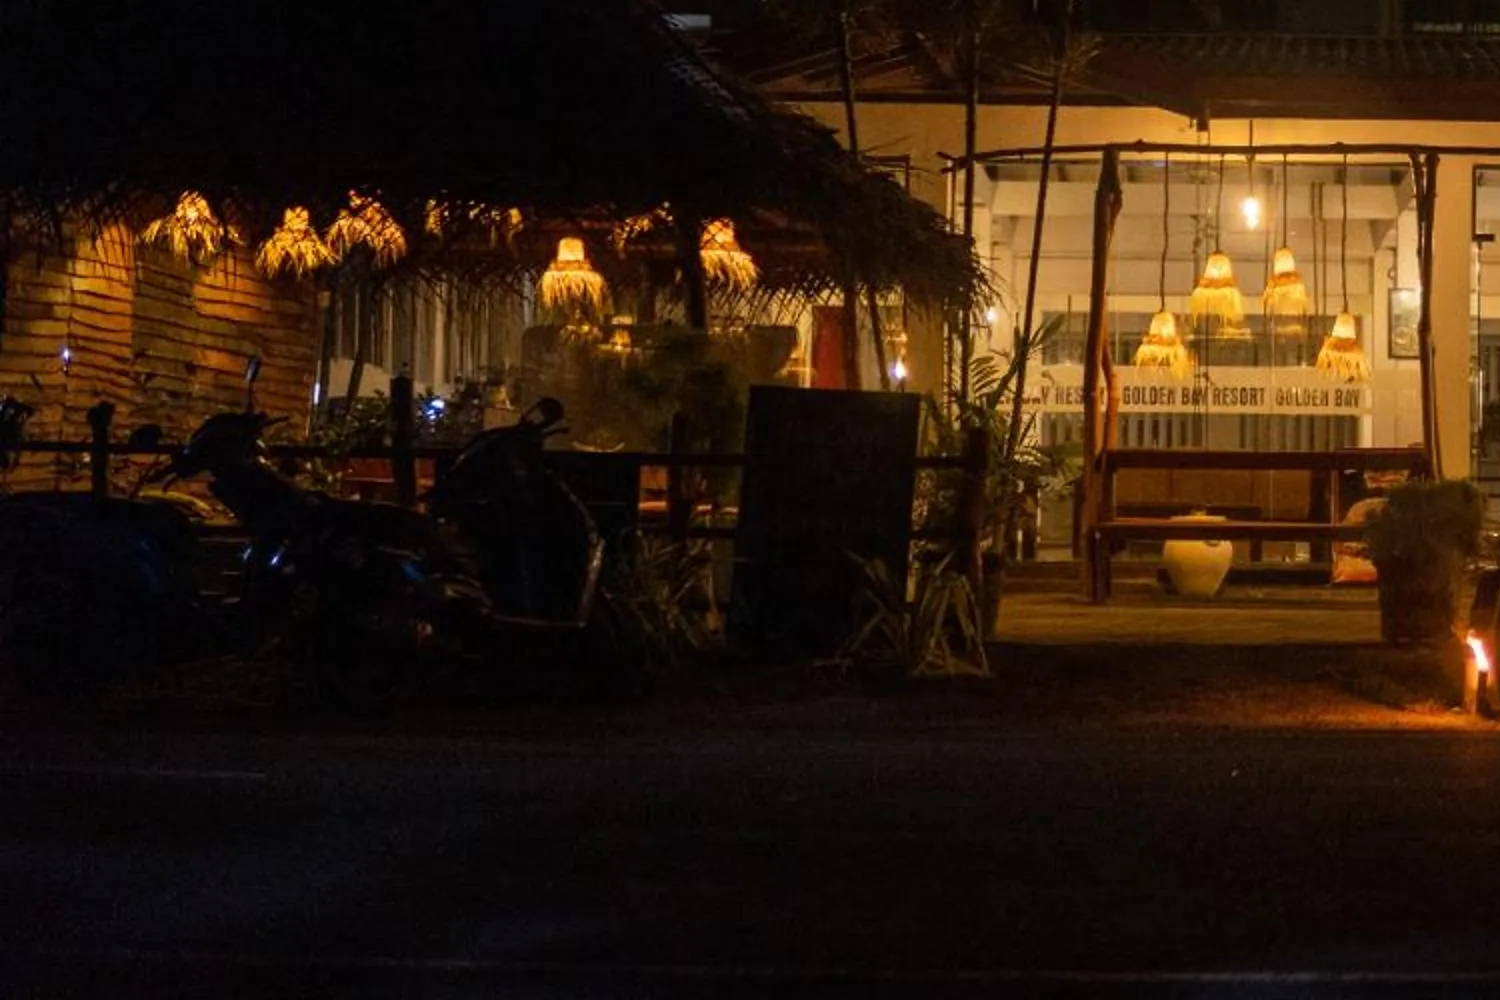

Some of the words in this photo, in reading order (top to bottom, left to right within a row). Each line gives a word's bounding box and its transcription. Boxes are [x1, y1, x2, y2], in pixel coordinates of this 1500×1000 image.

[1123, 386, 1176, 405] GOLDEN
[1181, 387, 1209, 406] BAY
[1213, 387, 1265, 406] RESORT
[1275, 387, 1329, 407] GOLDEN
[1335, 388, 1360, 408] BAY
